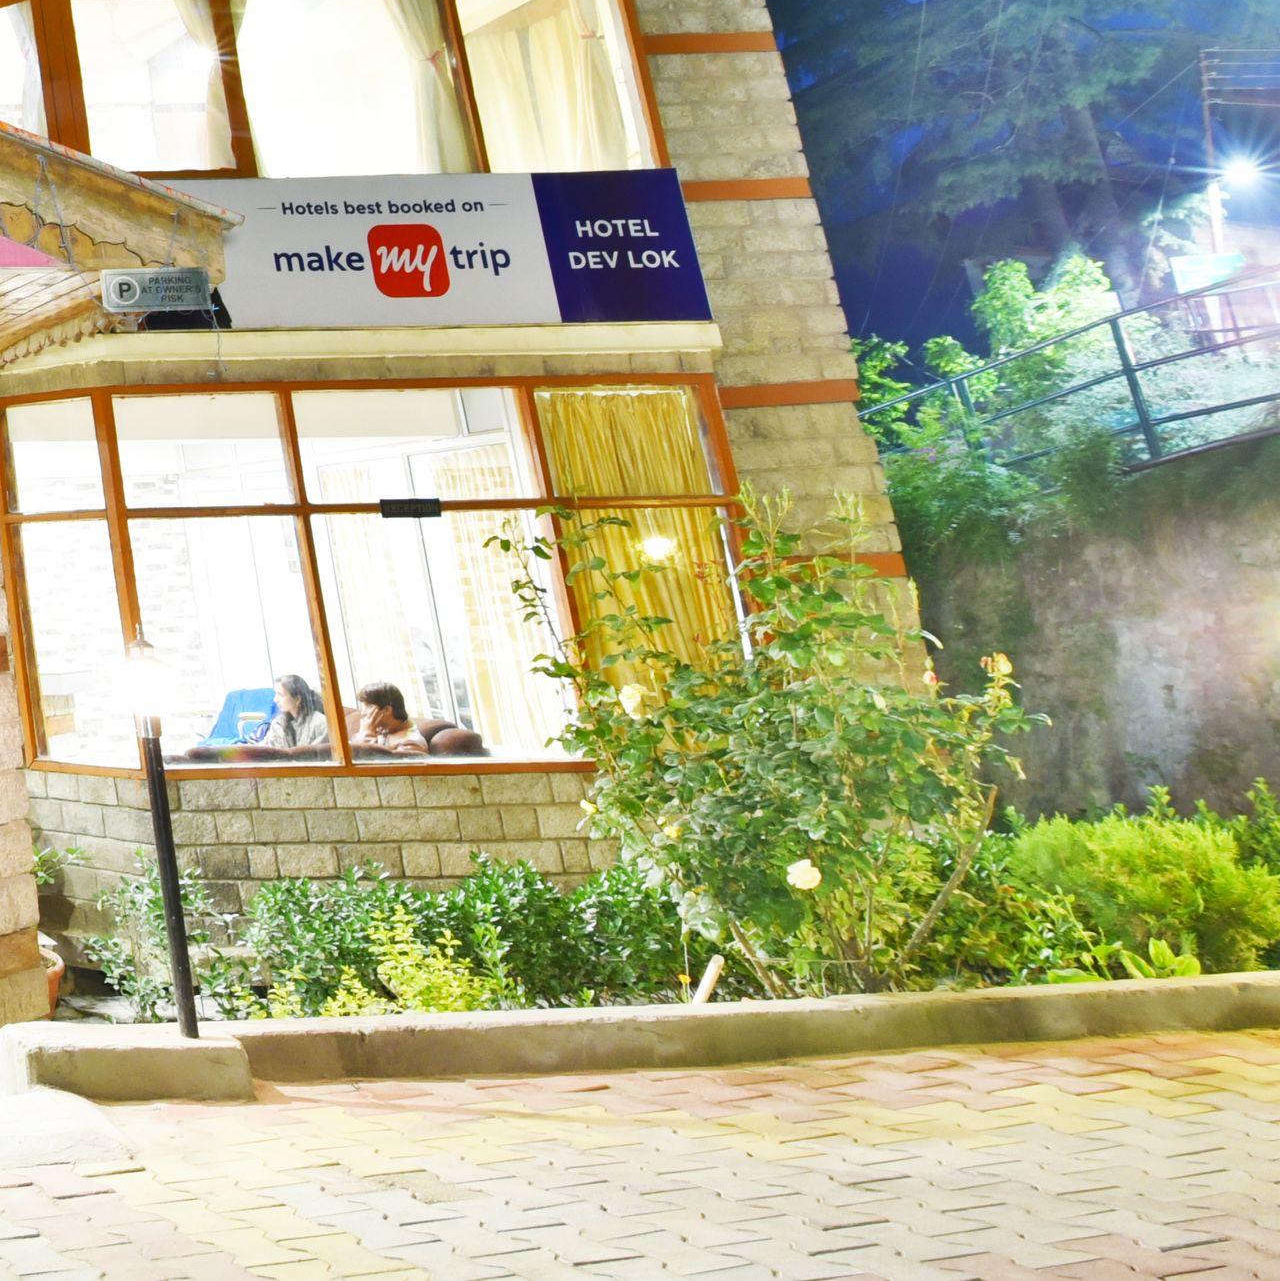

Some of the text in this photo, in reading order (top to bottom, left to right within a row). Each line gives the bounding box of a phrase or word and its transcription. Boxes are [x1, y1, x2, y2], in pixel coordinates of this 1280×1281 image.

[281, 200, 484, 215] Hotels best booked on
[575, 219, 660, 238] HOTEL
[273, 242, 511, 292] make my trip
[568, 250, 680, 270] DEV LOK
[148, 276, 193, 286] PARKING
[118, 282, 132, 299] P
[141, 286, 154, 295] AT
[161, 294, 185, 303] RISK
